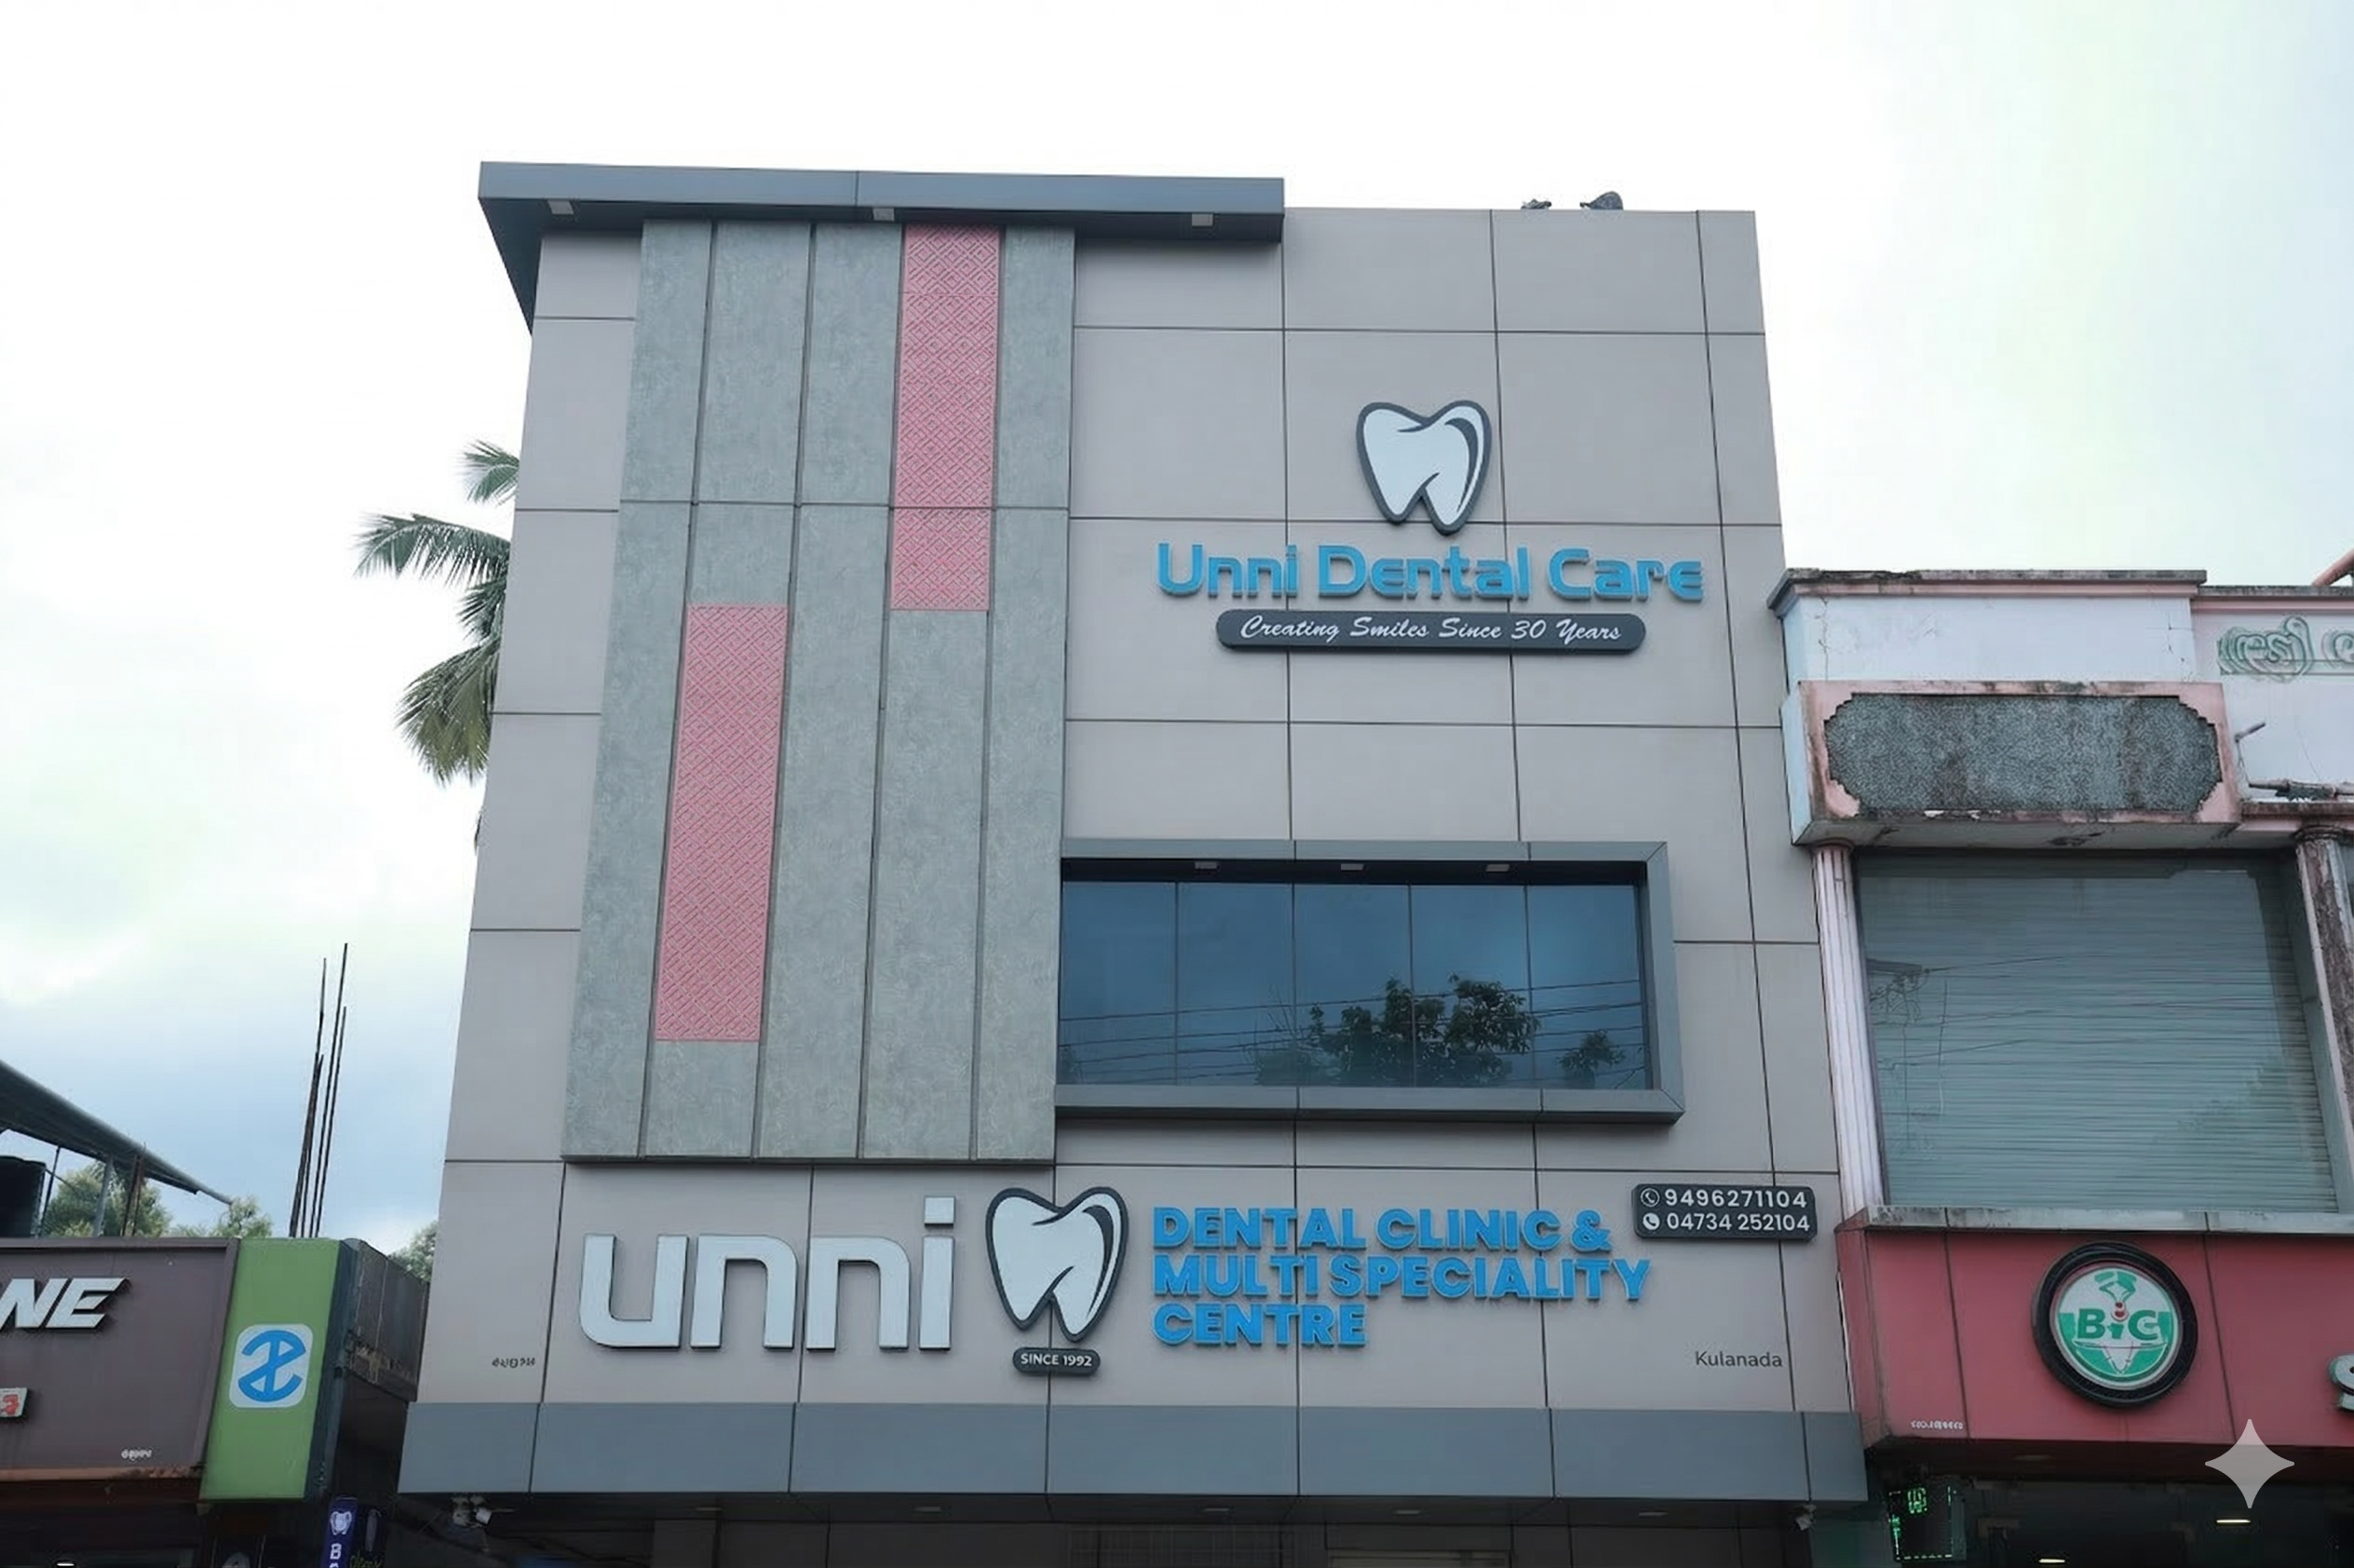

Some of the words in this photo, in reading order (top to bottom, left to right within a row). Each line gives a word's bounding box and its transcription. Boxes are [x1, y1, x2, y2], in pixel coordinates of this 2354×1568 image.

[1157, 542, 1299, 598] Unni
[1318, 545, 1531, 601] Dental
[1549, 547, 1704, 602] Care
[1240, 614, 1340, 642] Creating
[1349, 616, 1429, 640] Smiles
[1439, 618, 1502, 641] Since
[1510, 619, 1546, 640] 30
[1555, 619, 1622, 644] Years
[1664, 1188, 1807, 1209] 9496271104
[1152, 1206, 1368, 1251] DENTAL
[1375, 1208, 1564, 1252] CLINIC
[1570, 1210, 1612, 1252] &
[1667, 1212, 1732, 1231] 04734
[1738, 1213, 1810, 1232] 252104
[579, 1196, 955, 1351] unni
[1153, 1253, 1320, 1297] MULTI
[1329, 1256, 1651, 1304] SPECIALITY
[1152, 1301, 1368, 1347] CENTRE
[1021, 1353, 1059, 1365] SINCE
[1063, 1355, 1092, 1367] 1992
[1695, 1351, 1782, 1368] Kulanada
